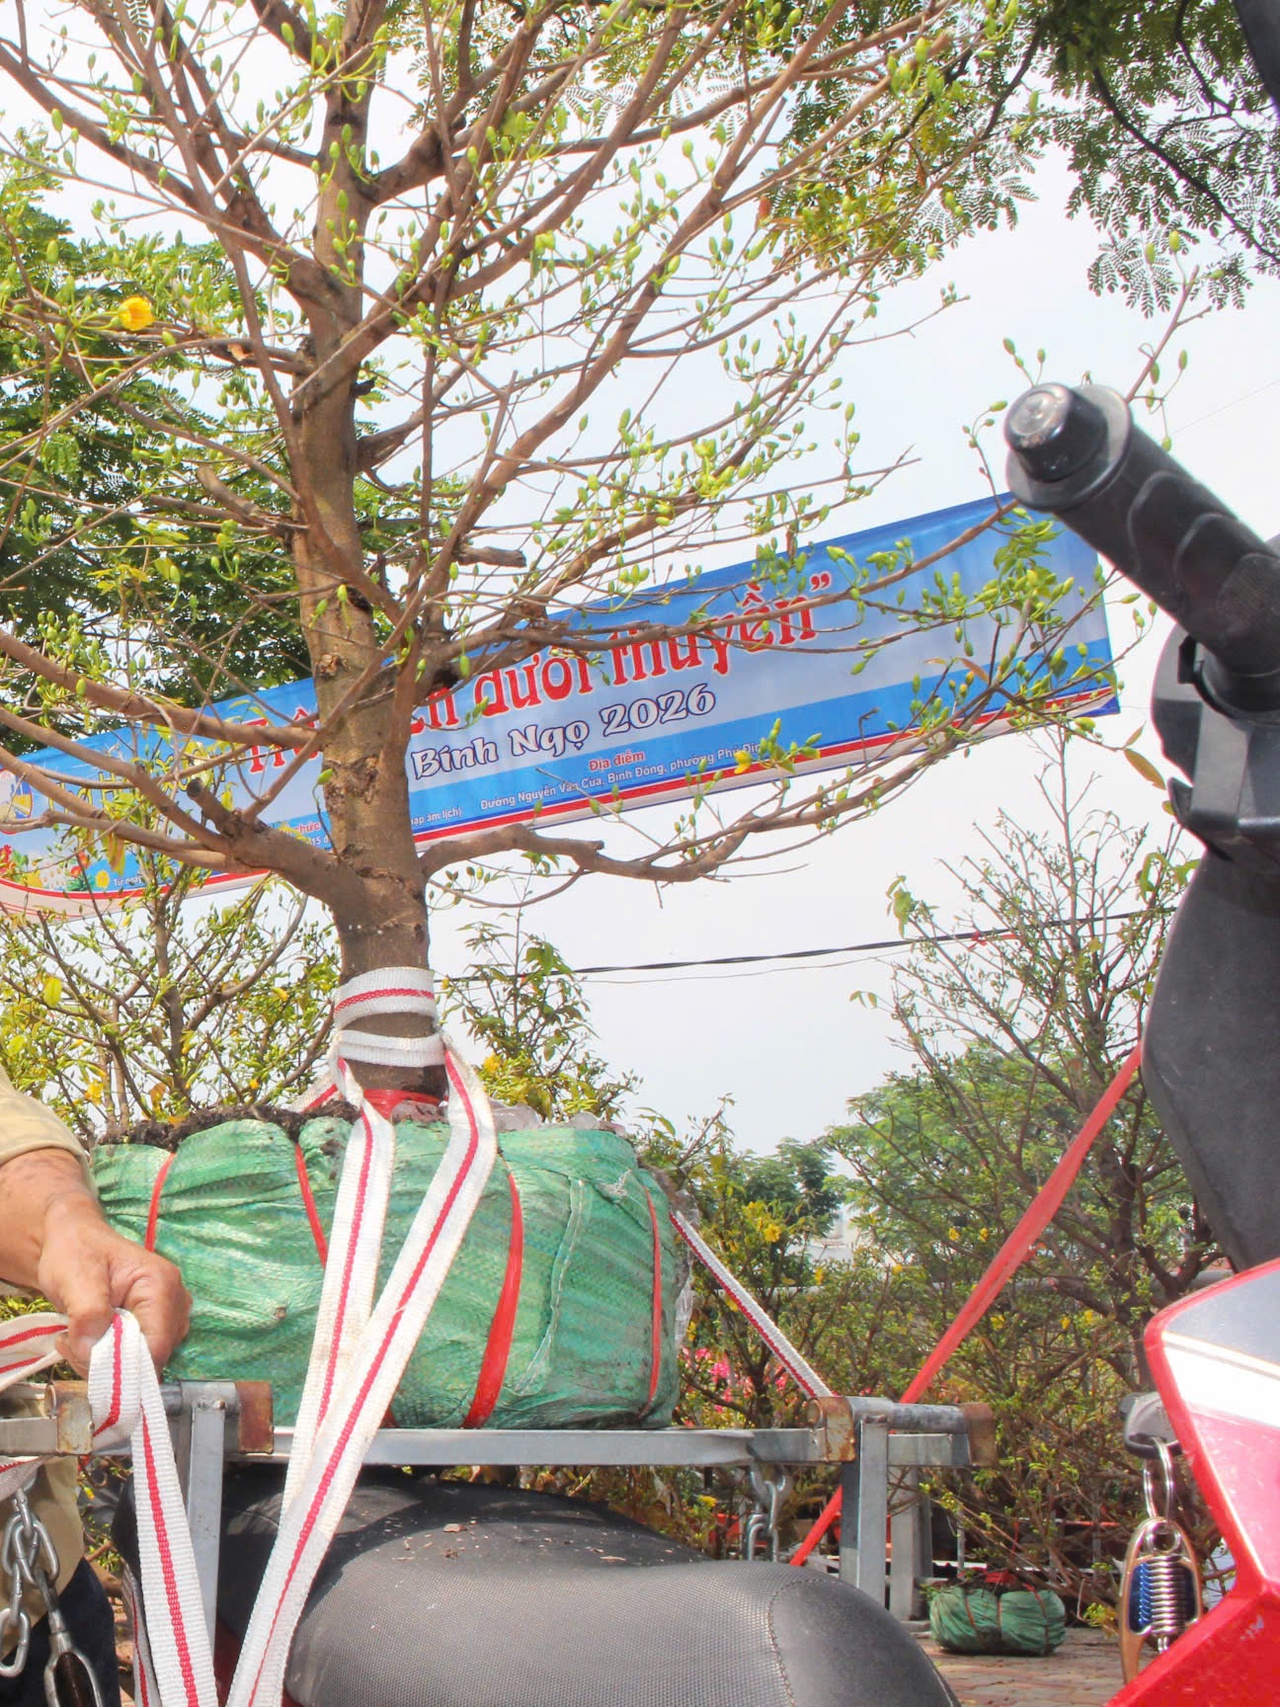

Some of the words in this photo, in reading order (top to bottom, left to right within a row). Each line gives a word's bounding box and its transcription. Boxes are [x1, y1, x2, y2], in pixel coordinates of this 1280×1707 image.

[411, 737, 499, 780] Bính
[508, 720, 589, 757] Ngọ
[599, 683, 716, 737] 2026
[589, 759, 611, 772] Địa
[614, 750, 645, 767] điểm
